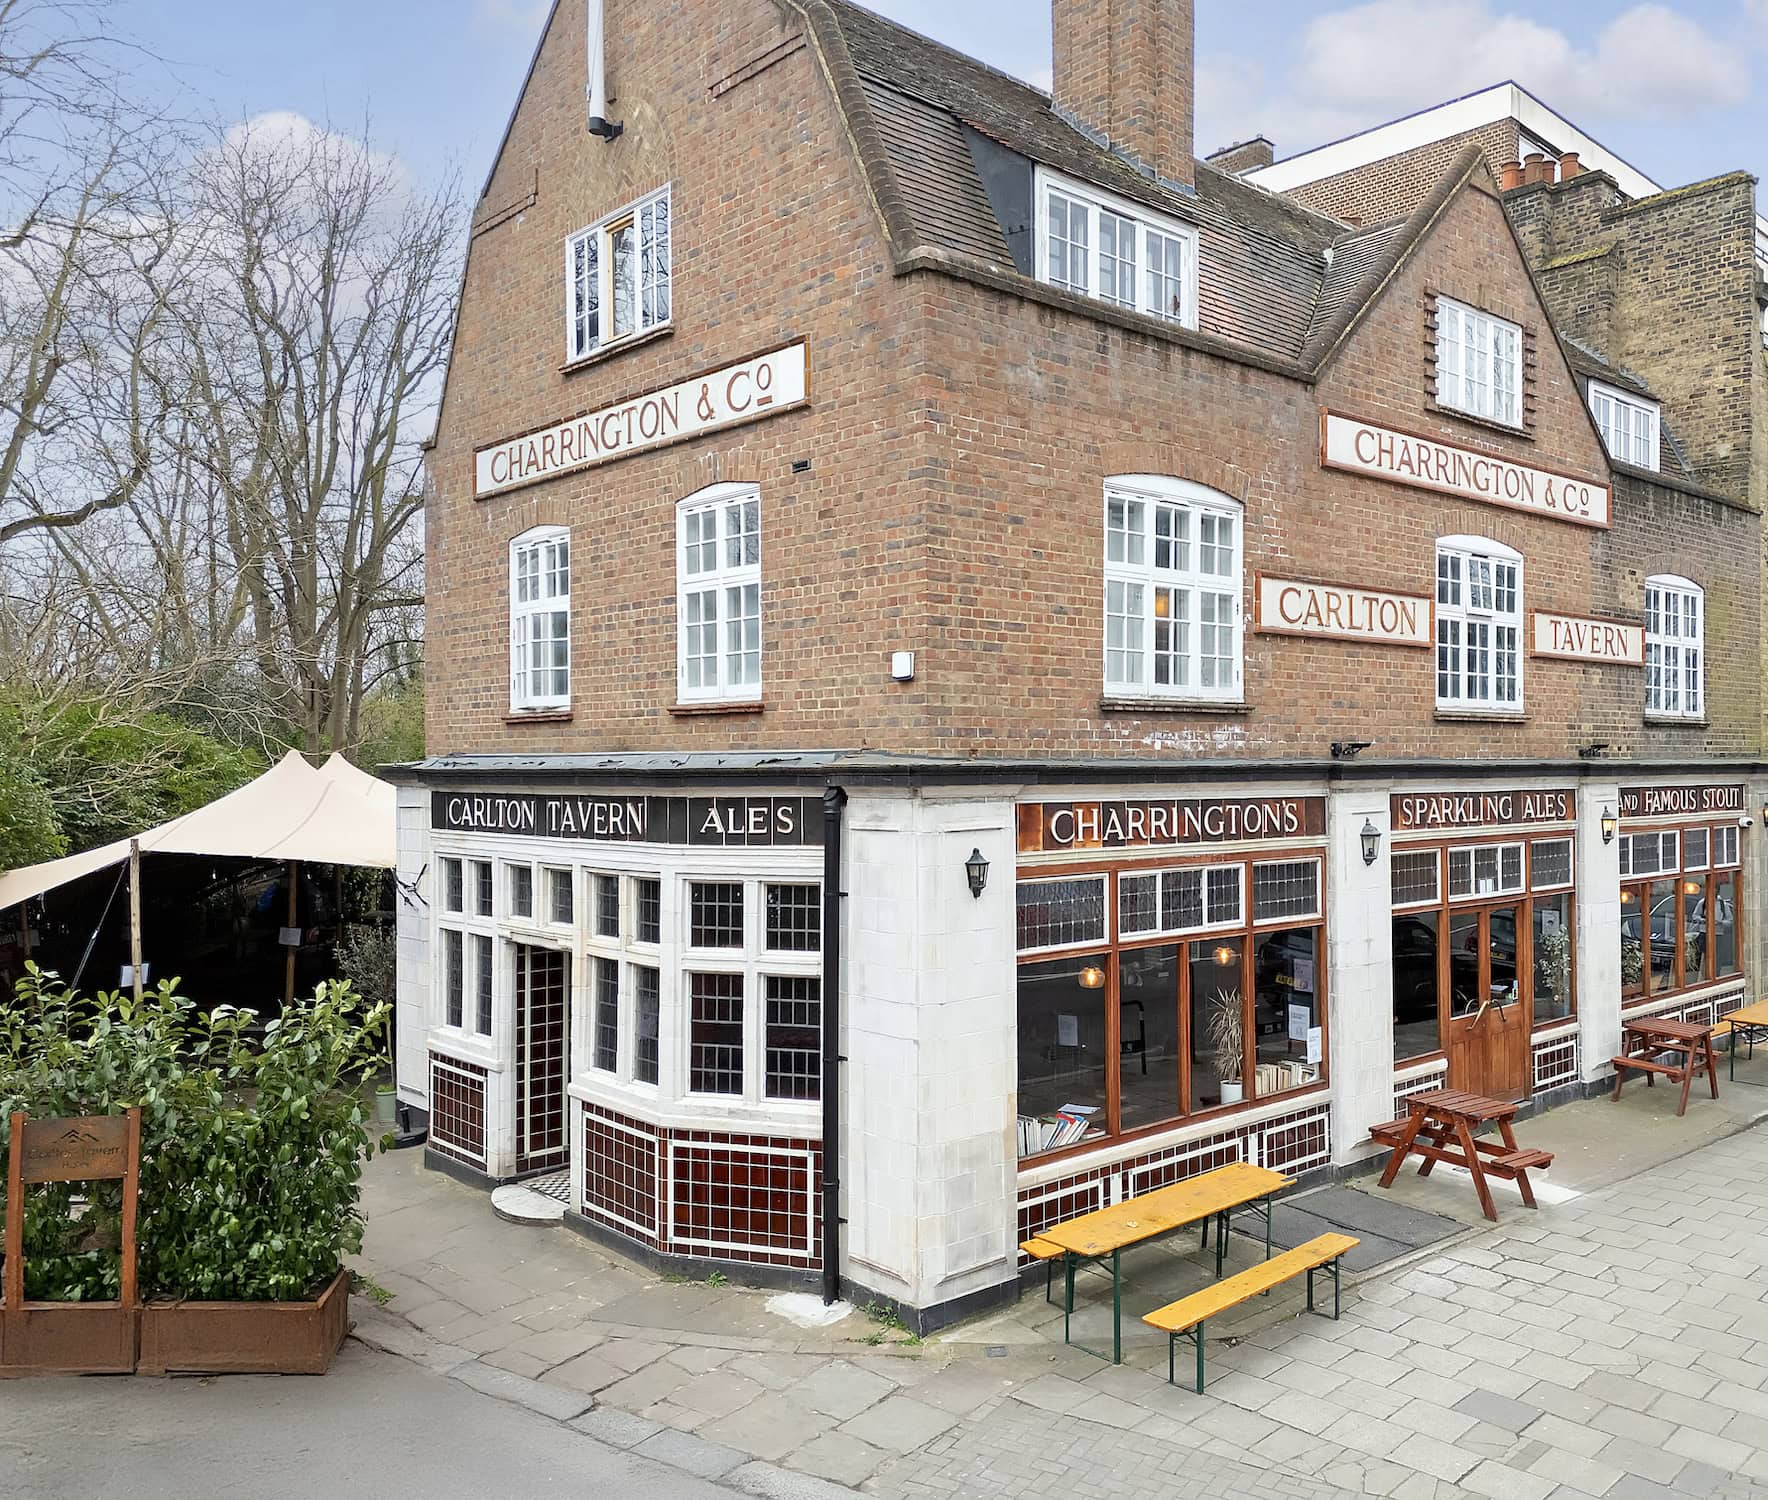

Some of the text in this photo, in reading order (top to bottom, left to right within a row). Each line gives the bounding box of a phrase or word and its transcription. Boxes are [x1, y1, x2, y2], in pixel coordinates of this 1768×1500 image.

[490, 392, 680, 484] CHARRINGTON
[696, 383, 716, 421] &
[1354, 429, 1535, 502] CHARRINGTON
[1545, 480, 1557, 508] &
[1278, 586, 1418, 635] CARLTON
[1550, 619, 1629, 657] TAVERN
[447, 798, 795, 836] CARLTON TAVERN ALES
[1402, 793, 1567, 826] SPARKLING ALES
[1644, 789, 1697, 812] FAMOUS
[1702, 787, 1740, 809] STOUT
